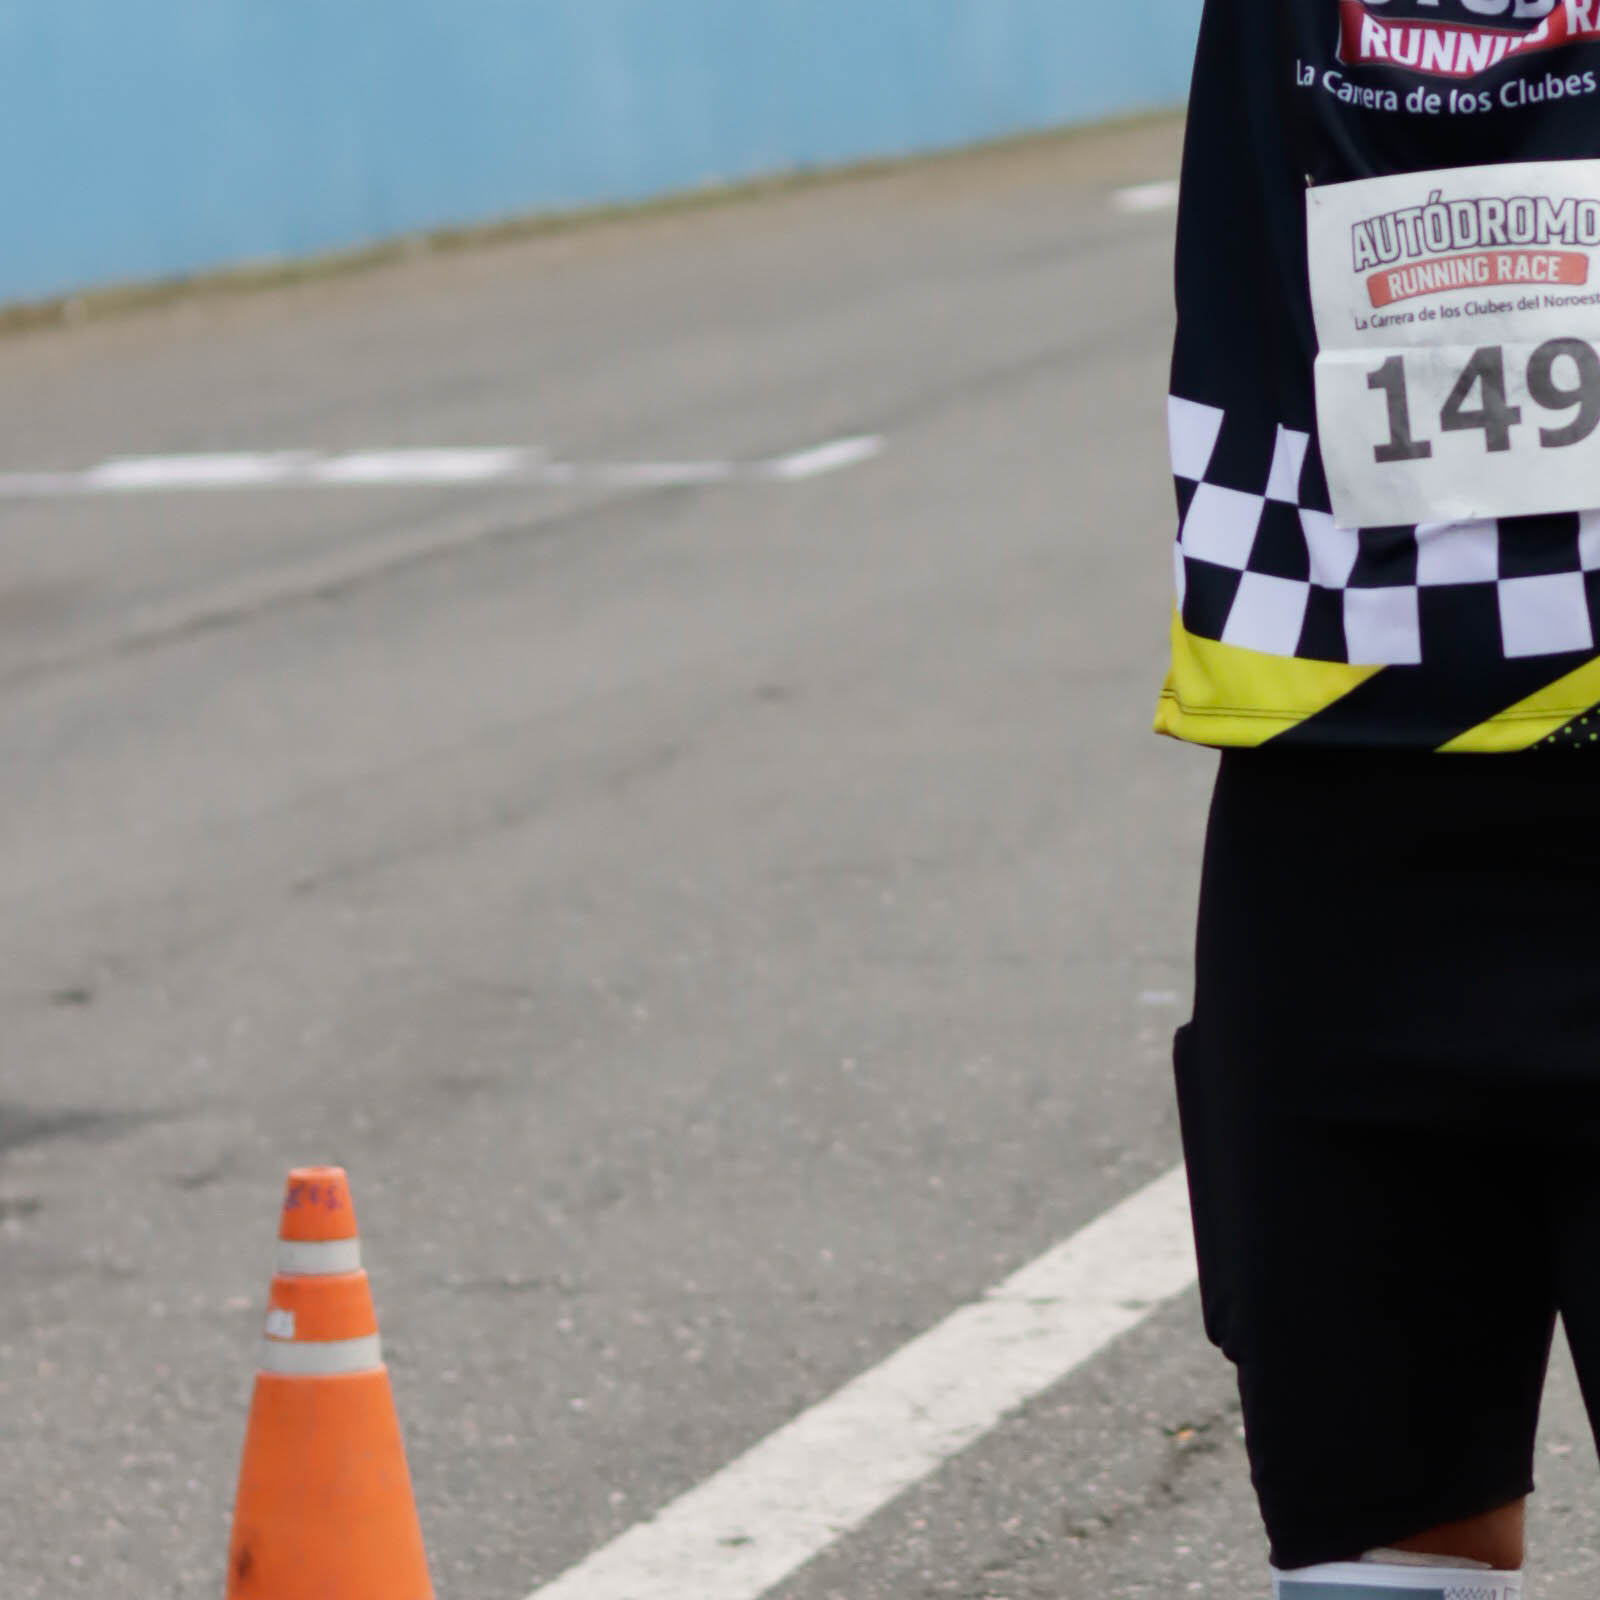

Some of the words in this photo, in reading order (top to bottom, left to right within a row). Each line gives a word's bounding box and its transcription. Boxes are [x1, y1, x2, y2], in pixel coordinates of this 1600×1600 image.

[1296, 59, 1316, 87] La
[1405, 86, 1442, 115] de
[1450, 89, 1493, 115] los
[1500, 72, 1597, 108] Clubes
[1387, 255, 1490, 300] RUNNING
[1498, 255, 1561, 282] RACE
[1354, 316, 1369, 331] La
[1370, 309, 1415, 329] Carrera
[1418, 306, 1436, 322] de
[1440, 302, 1462, 319] los
[1464, 297, 1514, 316] Clubes
[1517, 295, 1540, 311] del
